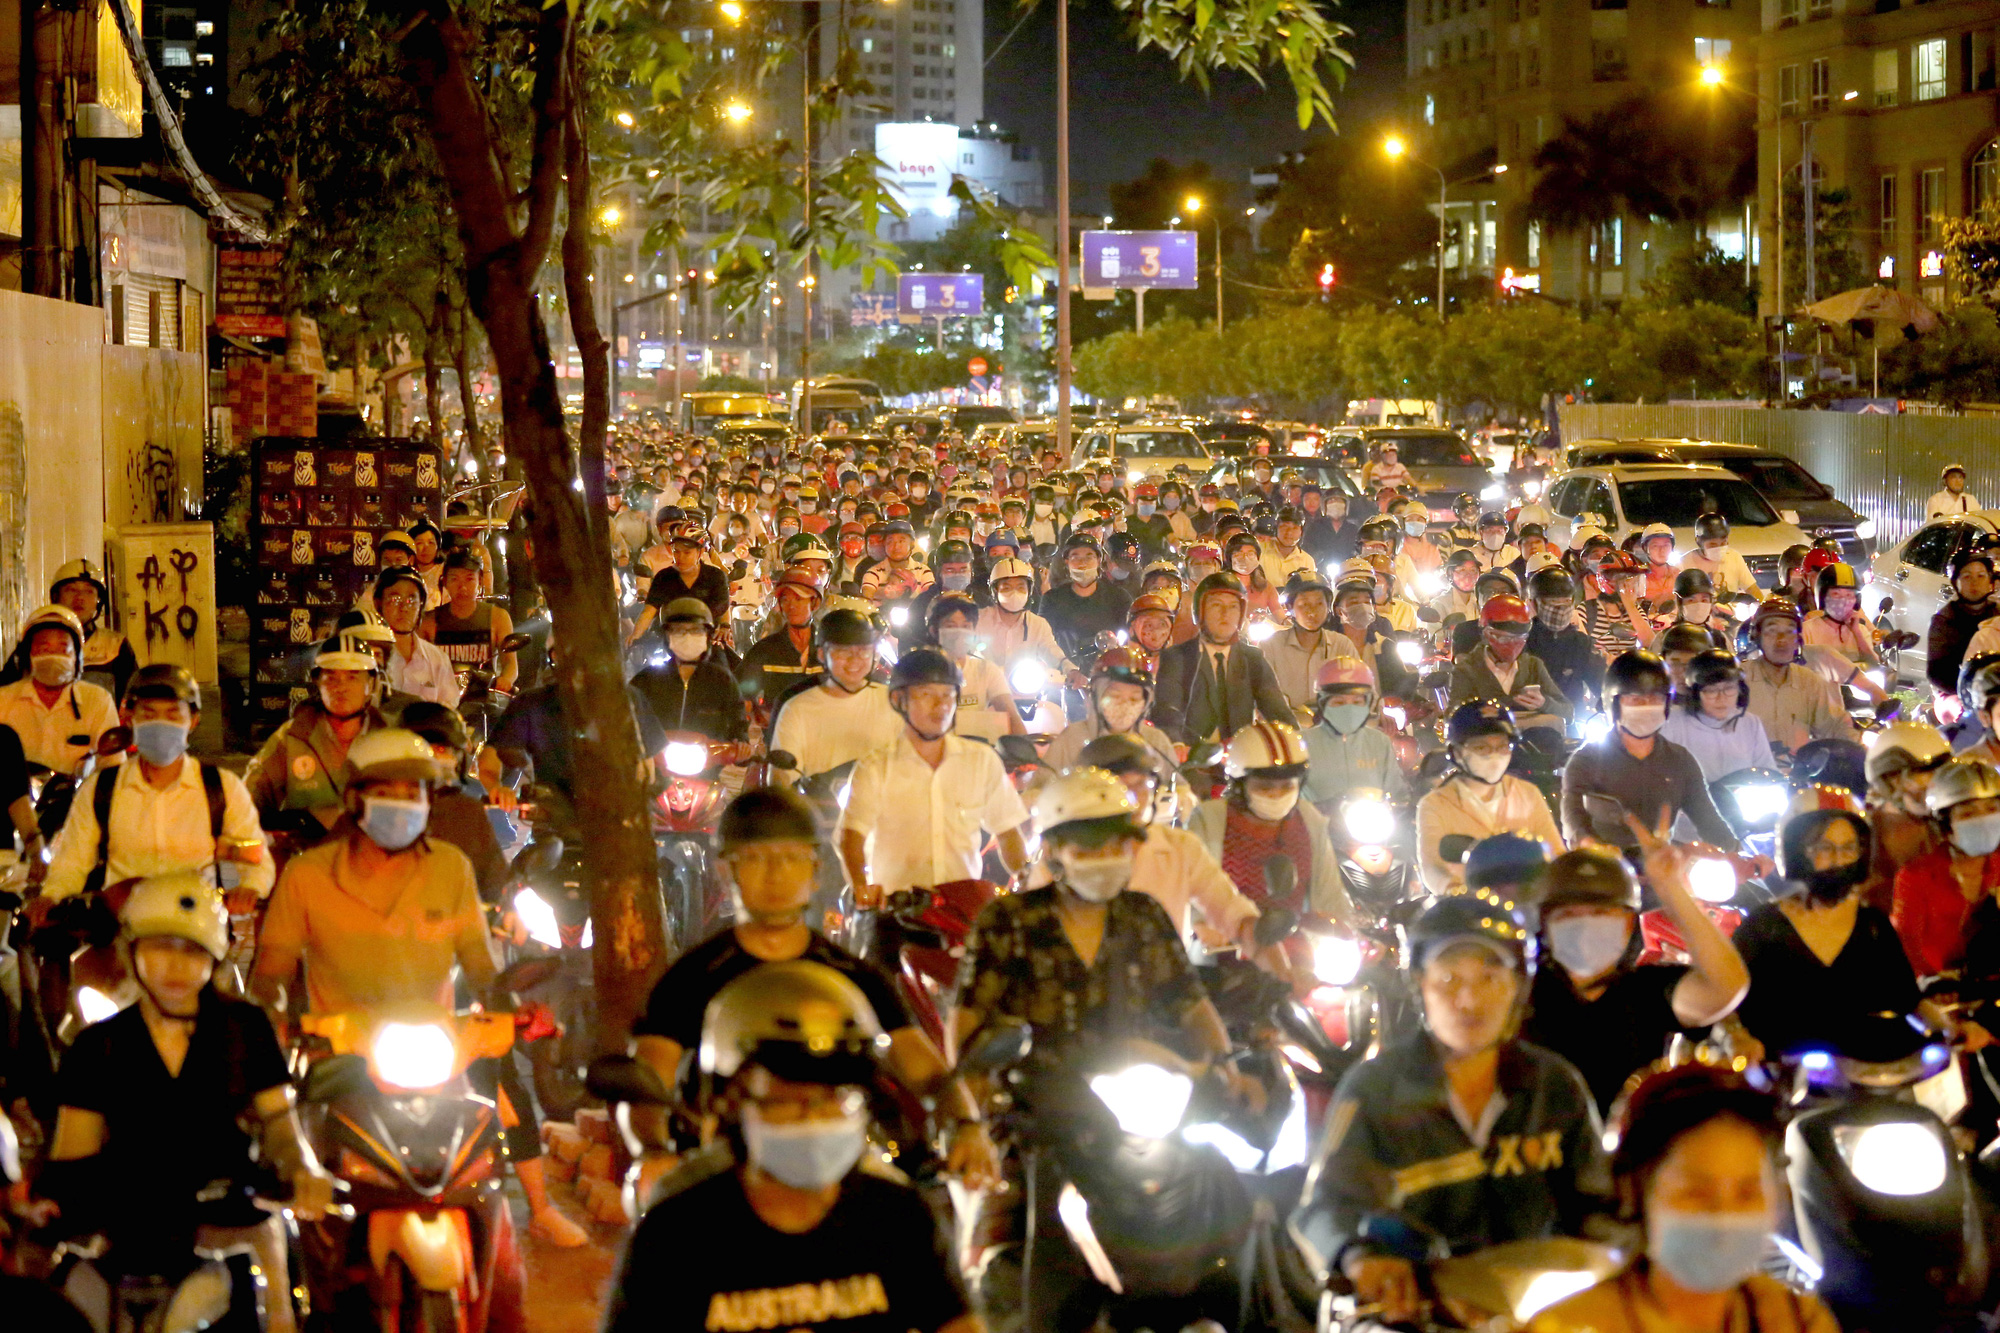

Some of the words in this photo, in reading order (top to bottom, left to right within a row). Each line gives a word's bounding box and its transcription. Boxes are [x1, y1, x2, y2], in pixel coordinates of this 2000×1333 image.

[1140, 246, 1161, 278] 3
[940, 285, 955, 308] 3
[266, 461, 292, 475] Tiger
[327, 462, 352, 476] Tiger
[388, 463, 414, 477] Tiger
[264, 540, 290, 554] Tiger
[325, 541, 351, 554] Tiger
[263, 618, 288, 632] Tiger
[704, 1272, 889, 1333] AUSTRALIA
